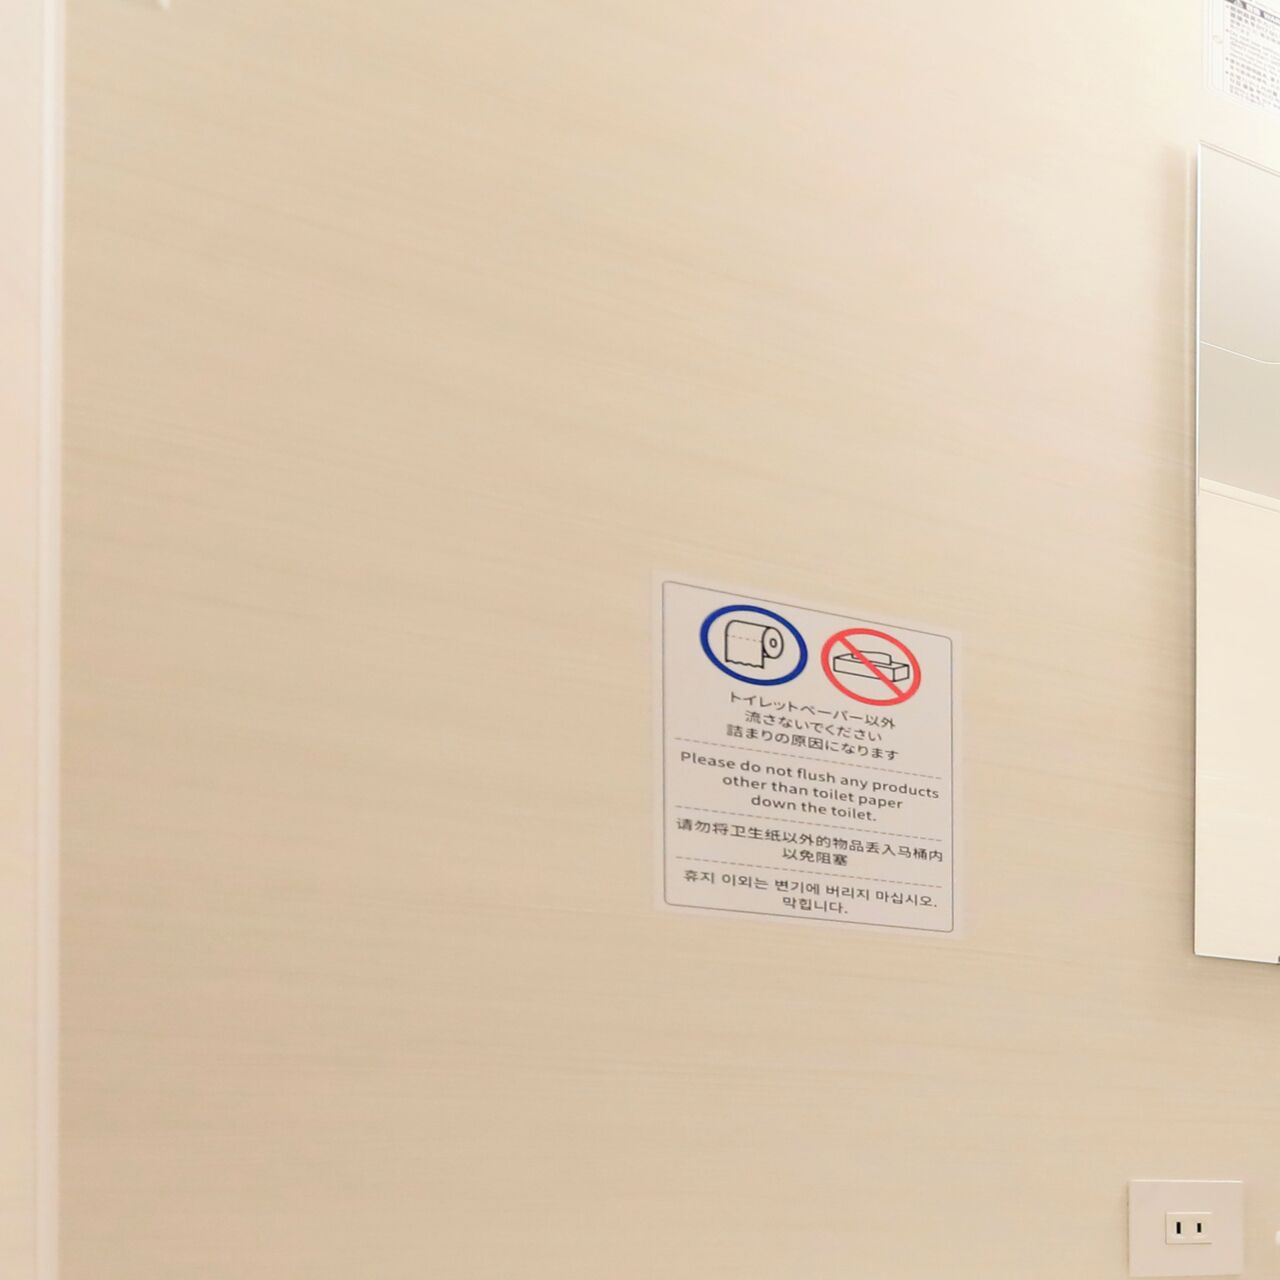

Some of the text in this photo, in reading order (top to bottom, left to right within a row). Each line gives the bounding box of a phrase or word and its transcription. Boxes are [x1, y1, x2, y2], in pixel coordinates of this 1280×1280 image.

[730, 691, 896, 729] トイレットペーパー以外
[745, 710, 882, 742] 流さないでください
[726, 724, 899, 761] 詰まりの原因になります
[681, 751, 940, 800] Please do not flush any products
[722, 775, 903, 813] other than toilet paper
[751, 794, 877, 822] down the toilet.
[676, 818, 944, 863] 请勿将卫生纸以外的物品丢入马桶内
[782, 847, 848, 867] 以免阻塞
[684, 869, 938, 908] 휴지 이외는 변기에 버리지 마십시오.
[782, 897, 848, 915] 막힙니다.
